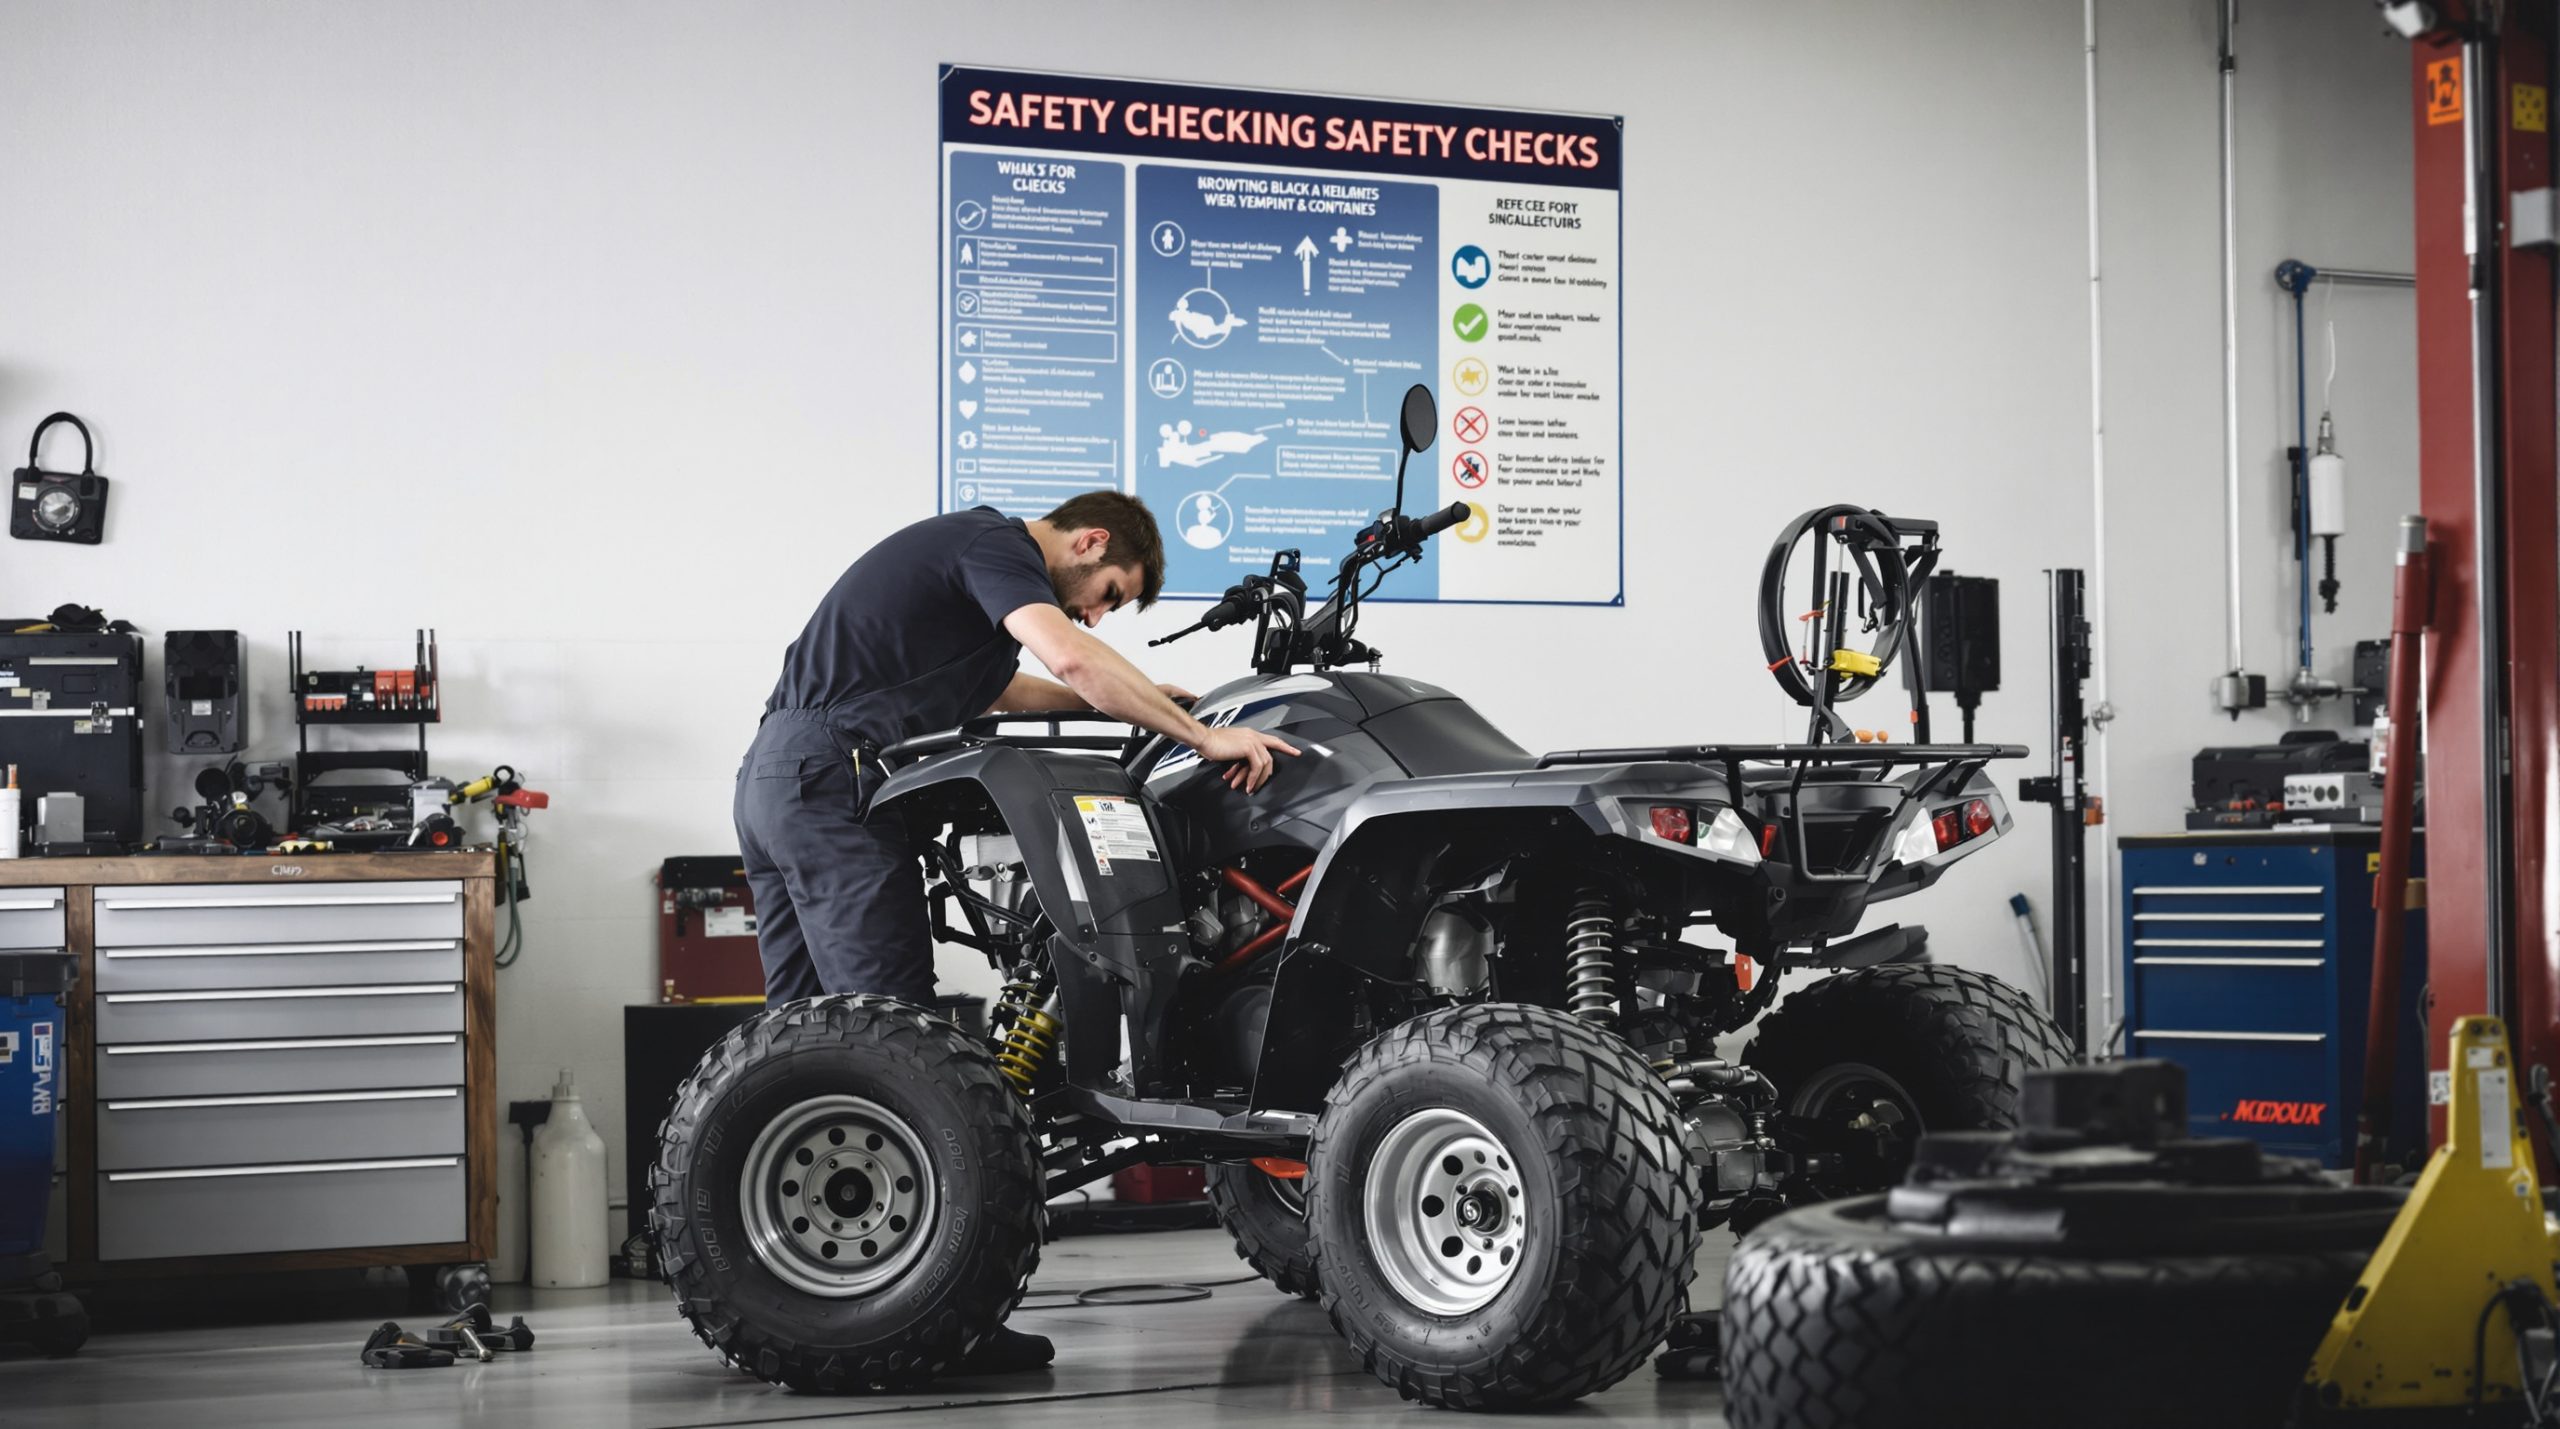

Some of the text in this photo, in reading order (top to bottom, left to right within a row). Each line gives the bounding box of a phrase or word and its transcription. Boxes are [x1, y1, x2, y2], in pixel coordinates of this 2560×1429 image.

[968, 90, 1599, 168] SAFETY CHECKING SAFETY CHECKS
[1049, 164, 1076, 179] FOR
[1270, 180, 1310, 196] BLACK
[1297, 198, 1307, 212] &
